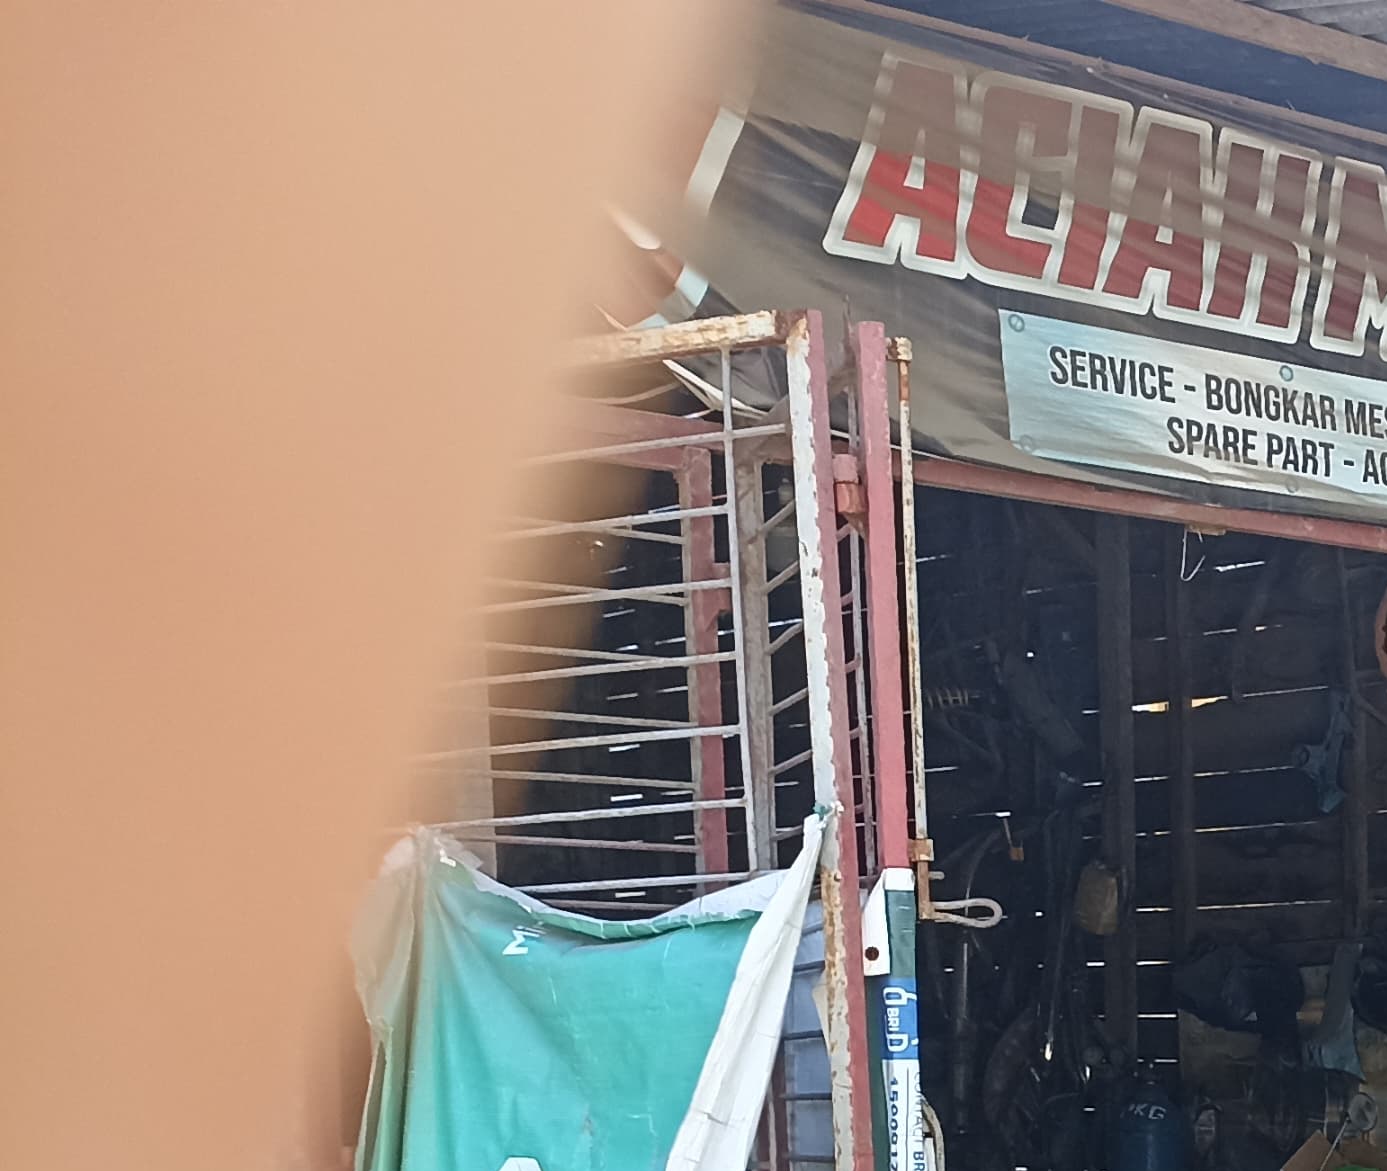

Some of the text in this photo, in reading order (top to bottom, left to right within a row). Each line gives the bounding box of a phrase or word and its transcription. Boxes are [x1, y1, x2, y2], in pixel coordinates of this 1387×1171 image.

[822, 48, 1322, 346] ACIAH
[1049, 345, 1177, 403] SERVICE
[1204, 373, 1338, 431] BONGKAR
[1166, 416, 1259, 467] SPARE
[1267, 432, 1335, 478] PART
